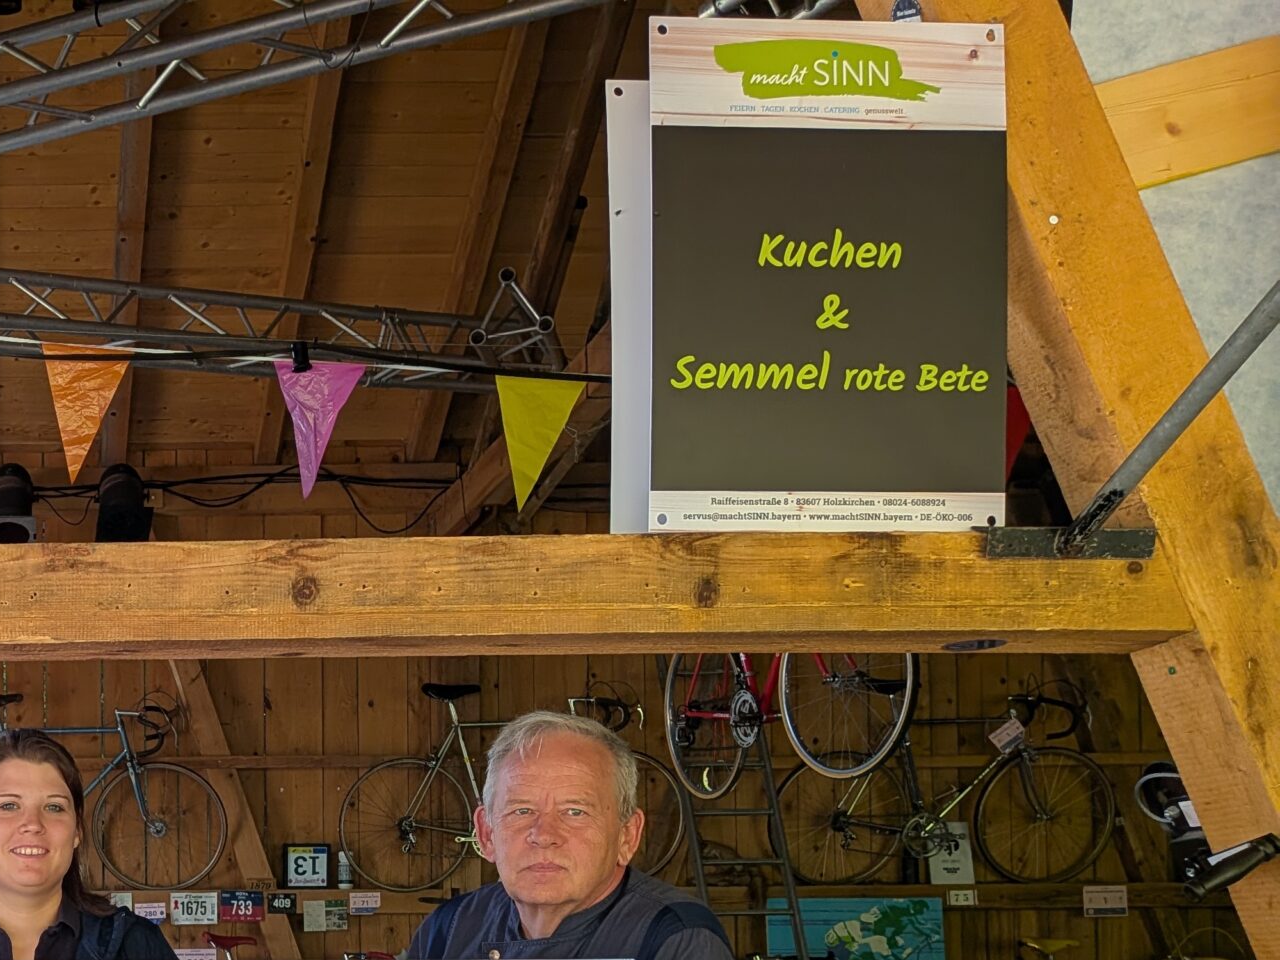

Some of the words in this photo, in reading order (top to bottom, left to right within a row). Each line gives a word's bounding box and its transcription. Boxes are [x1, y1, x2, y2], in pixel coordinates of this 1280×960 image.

[750, 64, 808, 85] macht
[813, 51, 890, 87] SINN
[729, 104, 756, 112] FEIERN
[761, 105, 785, 113] TAGEN
[864, 108, 904, 116] genusswelt
[757, 227, 902, 269] Kuchen
[815, 293, 850, 330] &
[670, 350, 832, 391] Semmel
[843, 363, 906, 391] rote
[915, 364, 990, 392] Bete
[710, 496, 782, 506] Raiffeisenstraße
[783, 498, 789, 506] 8
[796, 497, 821, 506] 83607
[823, 497, 876, 507] Holzkirchen
[882, 498, 946, 507] 08024-6088924
[683, 511, 802, 522] servus@machtSINN.bayern
[808, 512, 913, 523] www.machtSINN.bayern
[920, 512, 974, 522] DE-ÖKO-006
[180, 900, 207, 916] 1675
[230, 900, 253, 915] 733
[273, 898, 291, 908] 409
